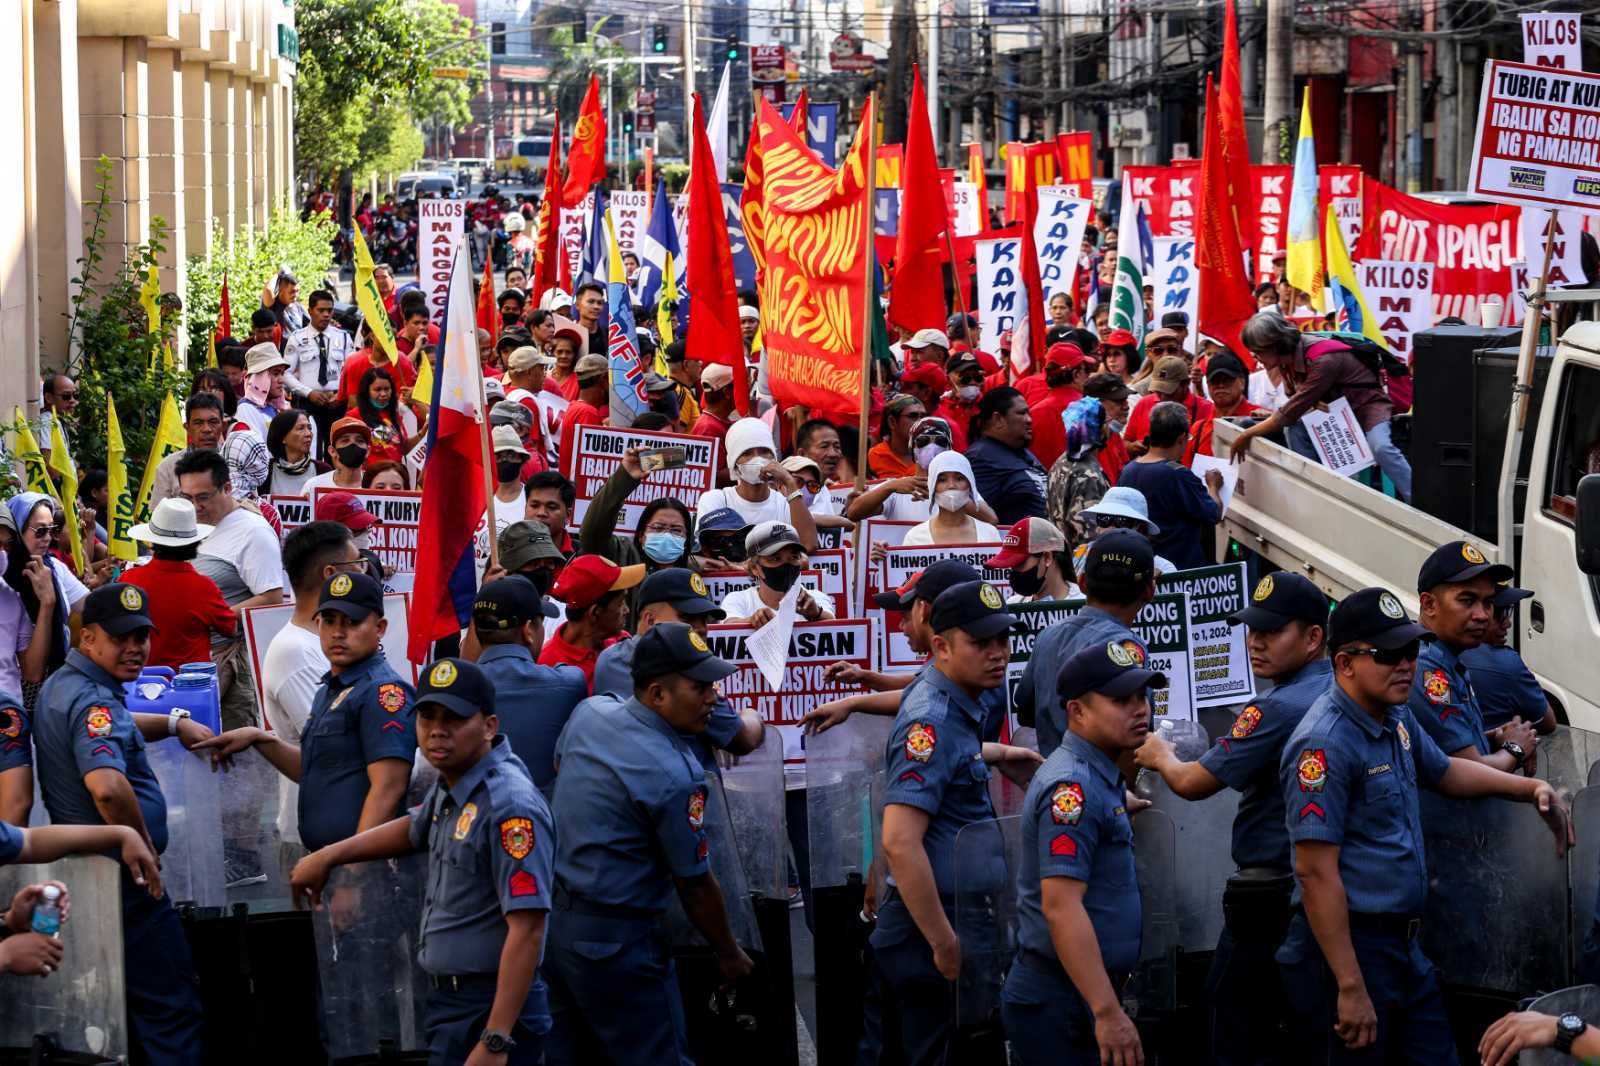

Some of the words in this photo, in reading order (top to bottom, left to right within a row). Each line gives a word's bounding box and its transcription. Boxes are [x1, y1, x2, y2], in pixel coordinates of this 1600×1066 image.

[1526, 20, 1577, 45] KILOS
[1499, 72, 1547, 100] TUBIG
[1550, 79, 1571, 103] AT
[1491, 103, 1546, 132] IBALIK
[1549, 110, 1571, 136] SA
[1497, 130, 1521, 156] NG
[422, 203, 462, 217] KILOS
[613, 194, 646, 206] KILOS
[1365, 266, 1429, 290] KILOS
[585, 433, 624, 455] TUBIG
[369, 528, 386, 548] SA
[1102, 553, 1132, 565] PULIS
[1174, 573, 1237, 597] NGAYONG
[1210, 626, 1233, 639] 2024
[708, 632, 855, 660] WAASAN
[757, 696, 777, 721] AT
